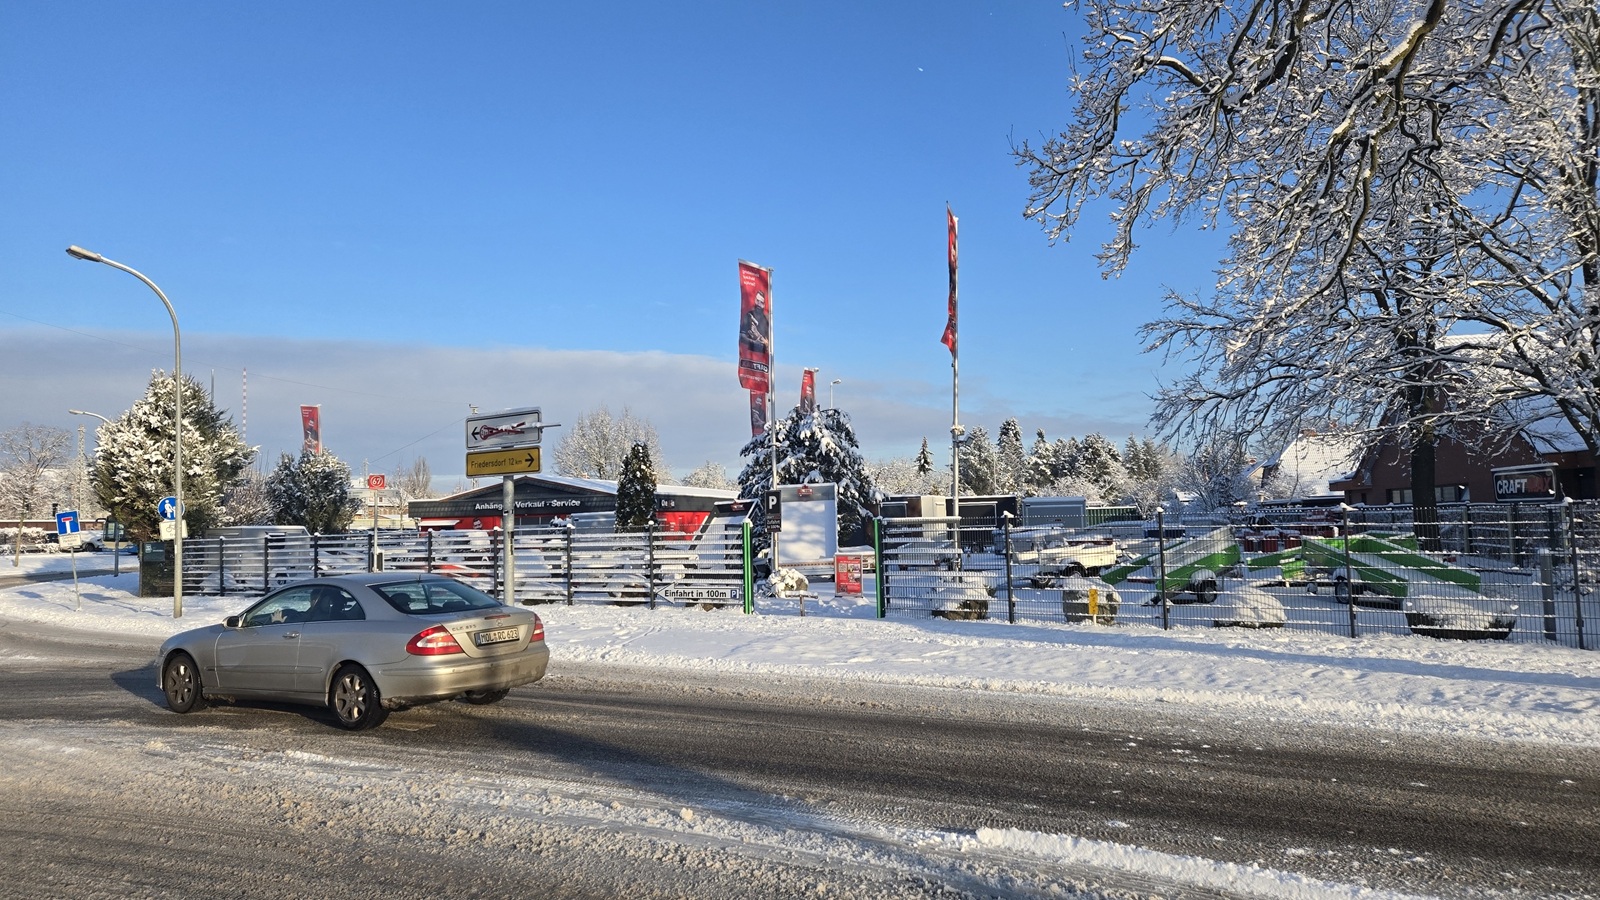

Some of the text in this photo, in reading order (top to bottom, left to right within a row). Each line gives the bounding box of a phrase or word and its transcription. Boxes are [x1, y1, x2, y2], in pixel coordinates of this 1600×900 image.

[470, 459, 507, 468] Friedersdorf
[508, 458, 515, 466] 12
[475, 499, 581, 511] Anhäng Verkauf Service
[769, 495, 778, 510] P
[664, 589, 694, 598] Einfahrt
[696, 590, 704, 598] in
[706, 589, 727, 598] 100m
